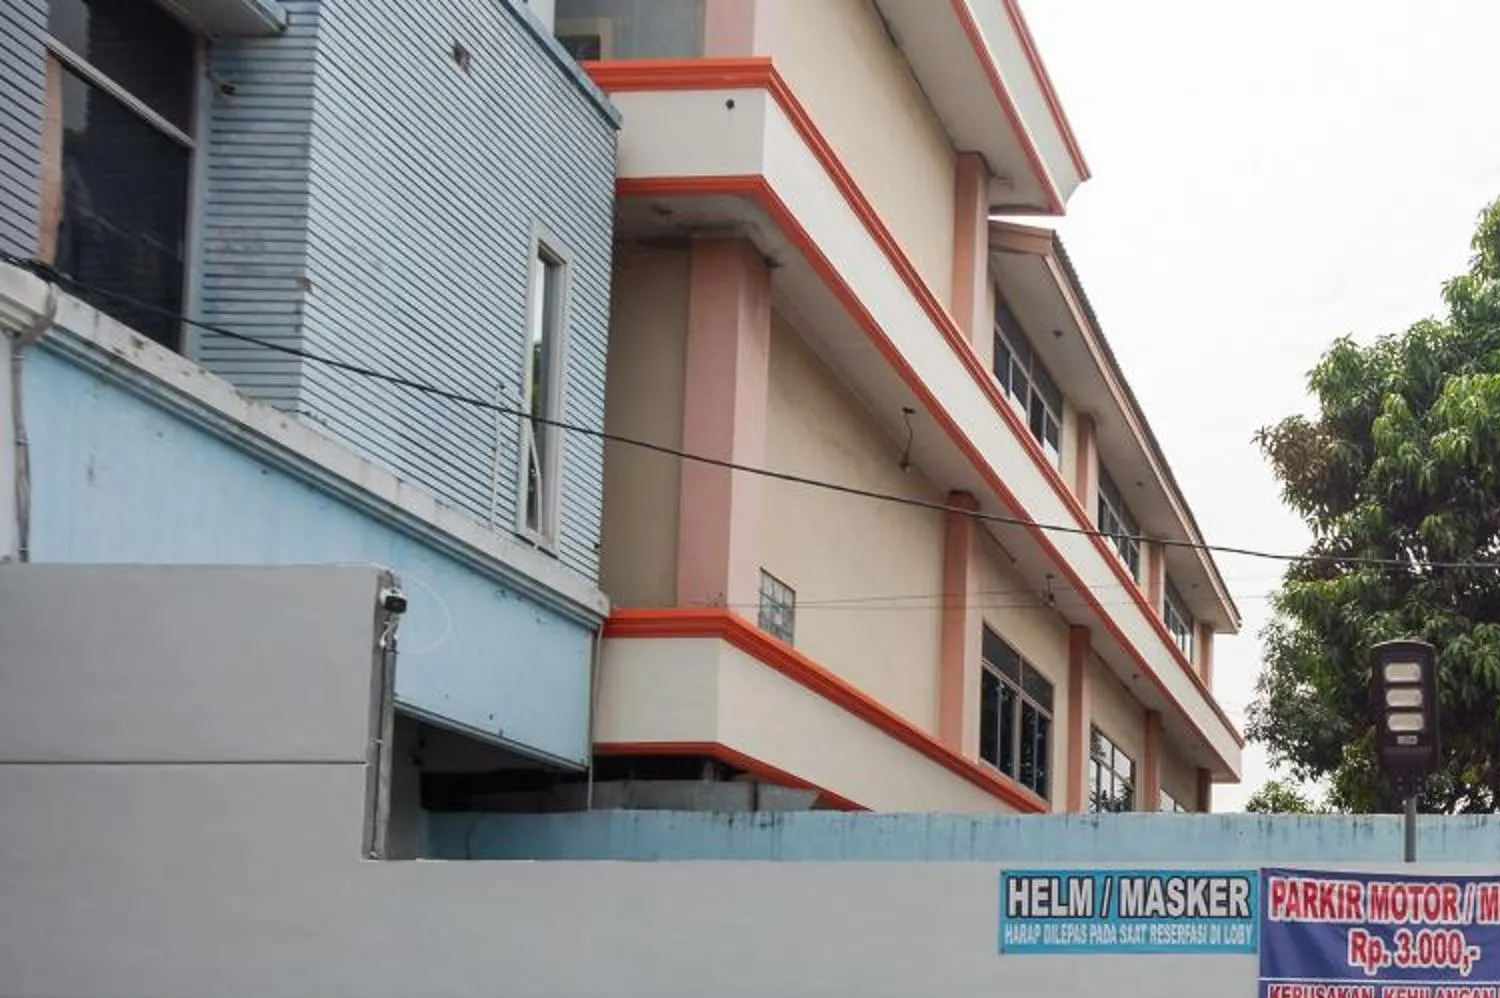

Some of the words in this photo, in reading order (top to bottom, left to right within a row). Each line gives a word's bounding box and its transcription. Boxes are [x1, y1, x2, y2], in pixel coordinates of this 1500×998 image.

[1006, 876, 1094, 918] HELM
[1100, 876, 1112, 918] /
[1118, 876, 1252, 919] MASKER
[1269, 877, 1364, 922] PARKIR
[1368, 880, 1459, 924] MOTOR
[1005, 923, 1041, 945] HARAP
[1043, 923, 1089, 945] DILEPAS
[1089, 923, 1117, 945] PADA
[1119, 923, 1148, 945] SAAT
[1210, 923, 1221, 945] DI
[1223, 923, 1253, 945] LOBY
[1349, 928, 1391, 975] Rp.
[1395, 928, 1480, 976] 3.000,-
